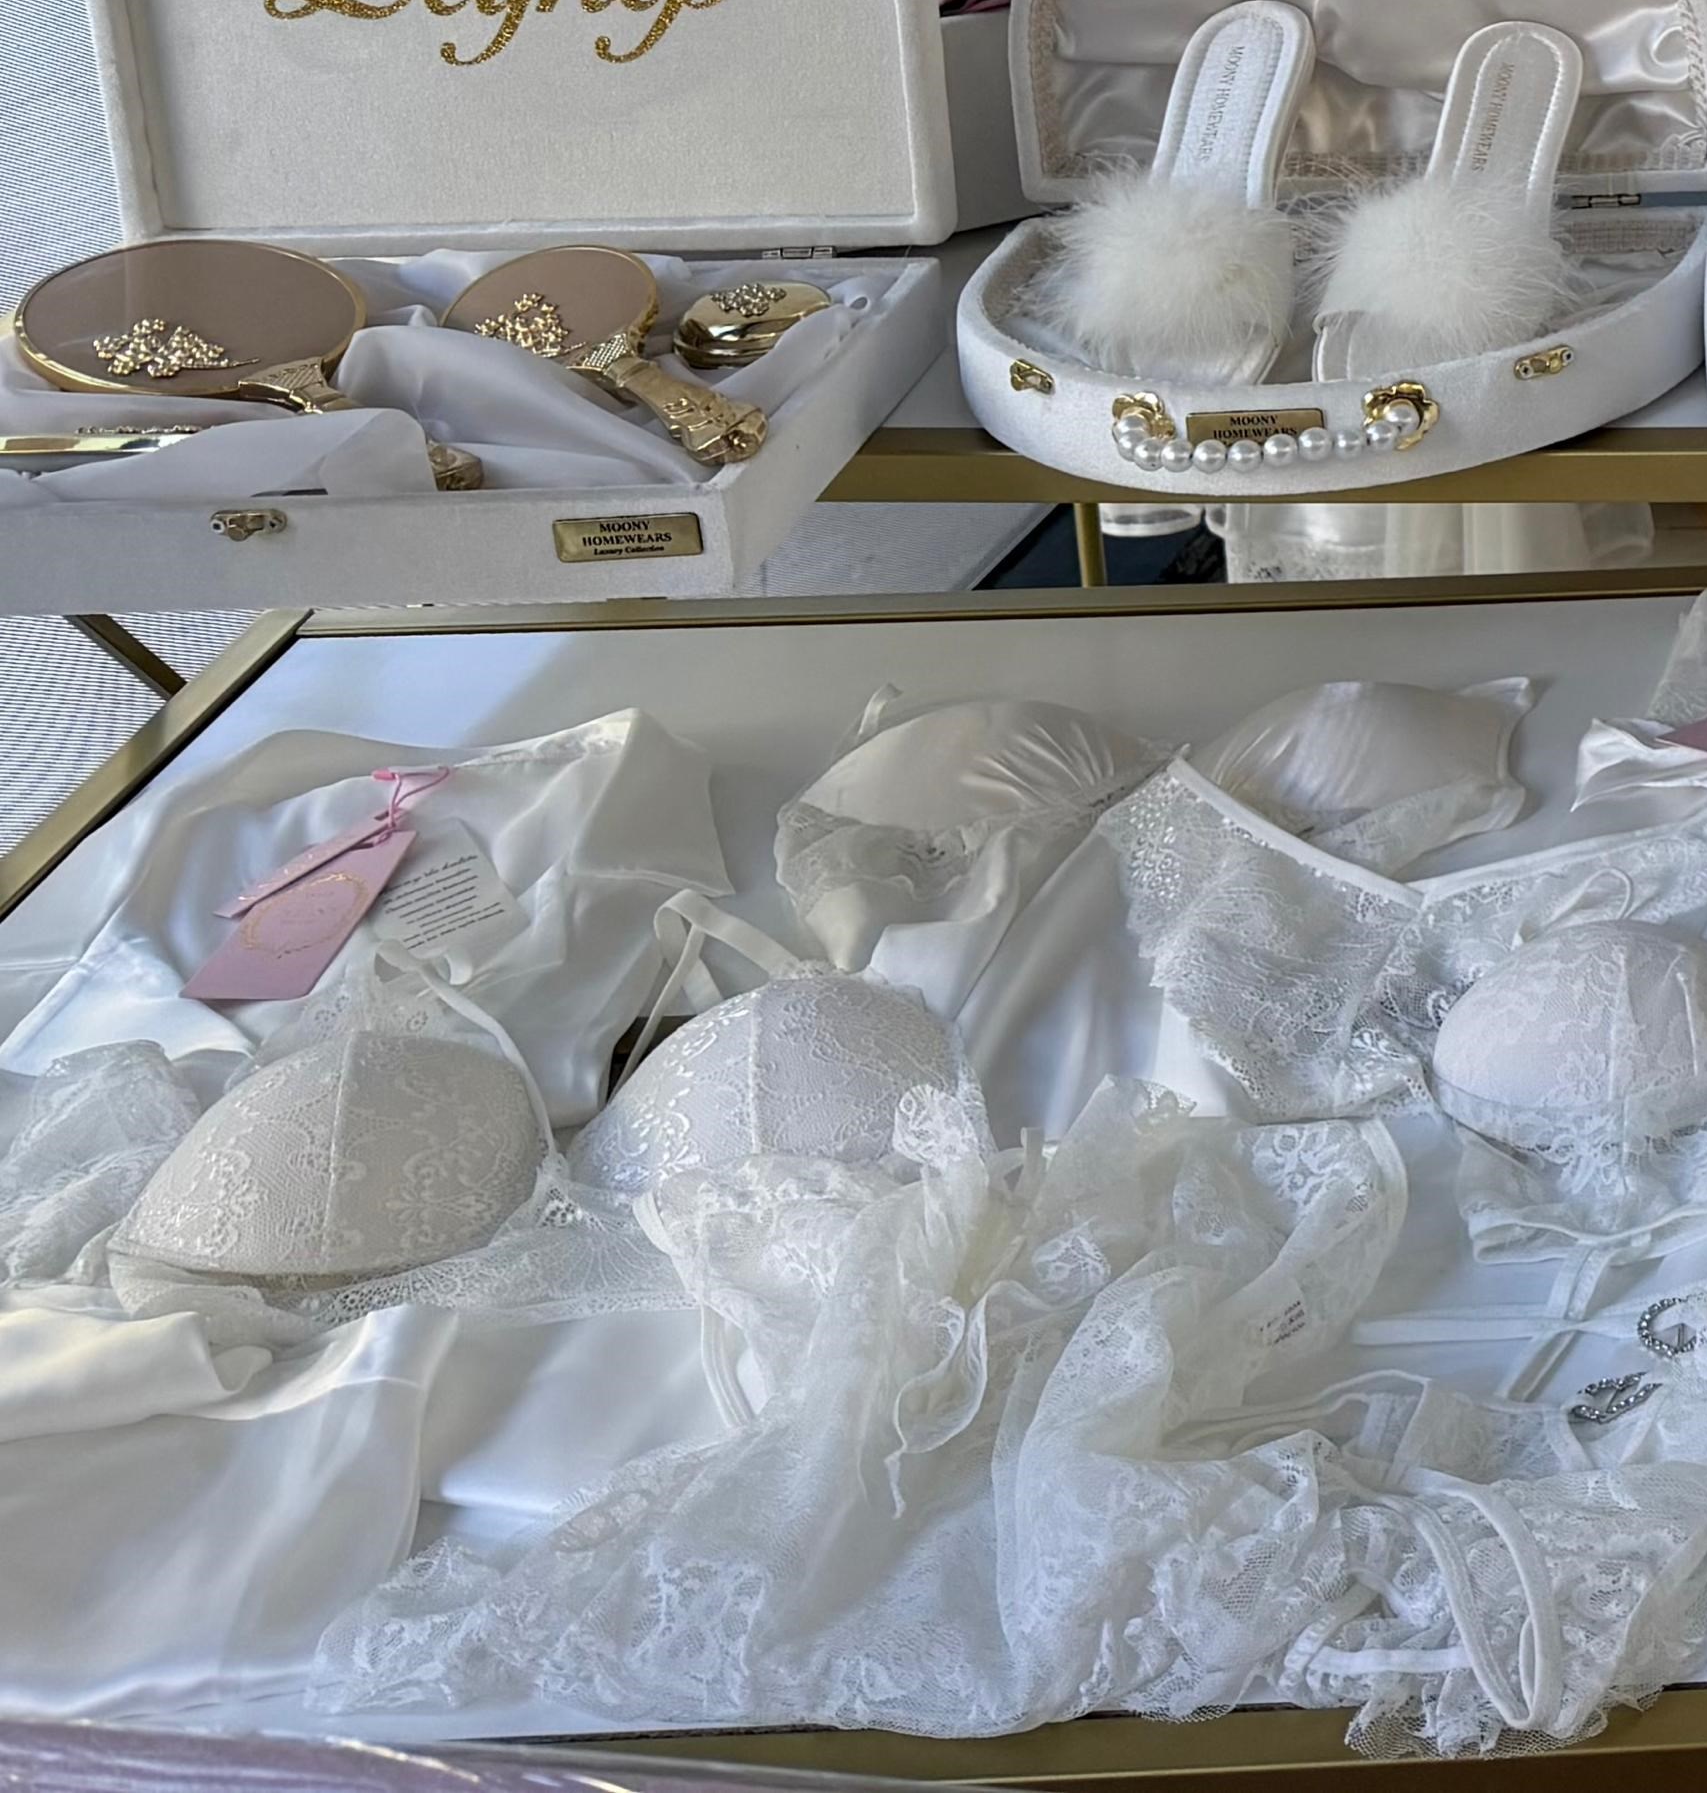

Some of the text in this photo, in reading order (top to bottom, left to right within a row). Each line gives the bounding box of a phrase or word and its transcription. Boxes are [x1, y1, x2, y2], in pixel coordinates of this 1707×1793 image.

[1219, 46, 1246, 91] MOONY
[1471, 62, 1515, 173] MOONY HOMEWEARS
[1229, 415, 1278, 426] MOONY
[1213, 428, 1298, 440] HOMEWEARS
[599, 521, 650, 533] MOONY
[582, 533, 672, 547] HOMEWEARS
[594, 545, 664, 556] Luxury Collection
